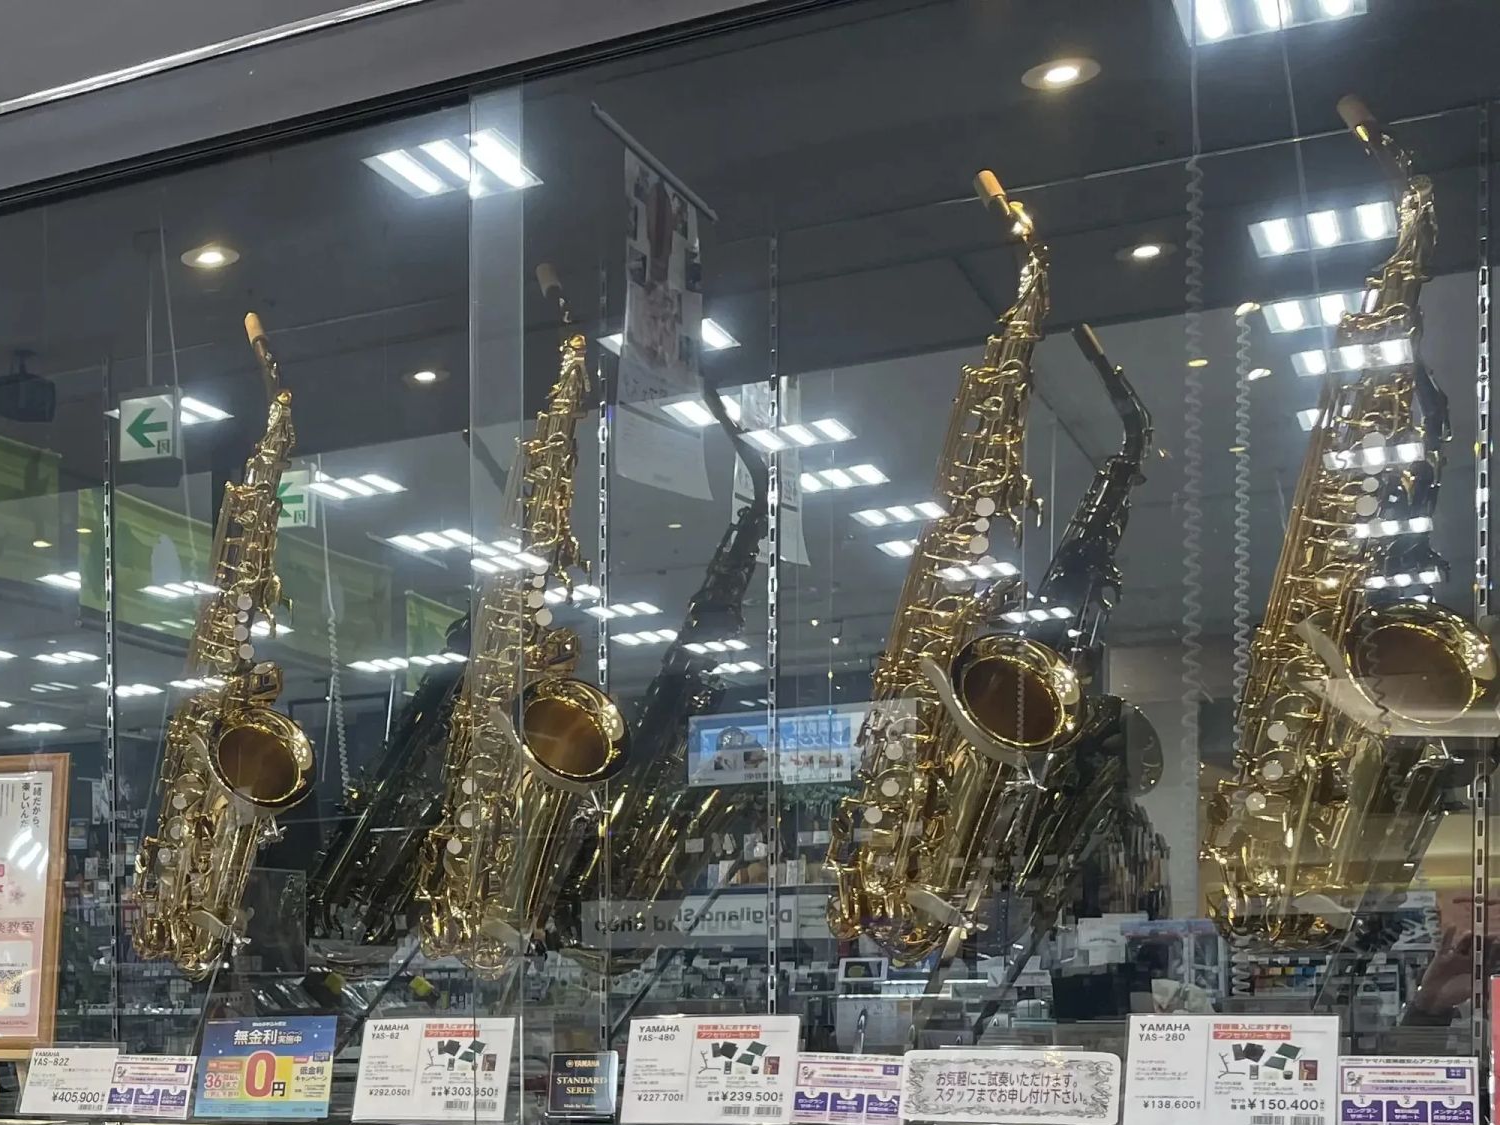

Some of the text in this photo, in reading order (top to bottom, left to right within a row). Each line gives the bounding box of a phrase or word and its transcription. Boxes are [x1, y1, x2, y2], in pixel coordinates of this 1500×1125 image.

[373, 1023, 409, 1031] YAMAHA
[639, 1025, 680, 1033] YAMAHA
[1139, 1023, 1191, 1032] YAMAHA
[233, 1028, 278, 1046] 無金利
[371, 1031, 400, 1040] YAS-62
[637, 1033, 676, 1042] YAS-480
[1138, 1033, 1186, 1042] YAS-280
[1216, 1032, 1289, 1040] アクセサリーセット
[573, 1059, 600, 1068] YAMAHA
[204, 1072, 222, 1090] 36
[556, 1075, 607, 1085] STANDARD
[935, 1071, 1079, 1088] お気軽にご試奏いただけます。
[566, 1085, 598, 1095] SERIES
[934, 1087, 1089, 1105] スタッフまでお申し付け下さい。
